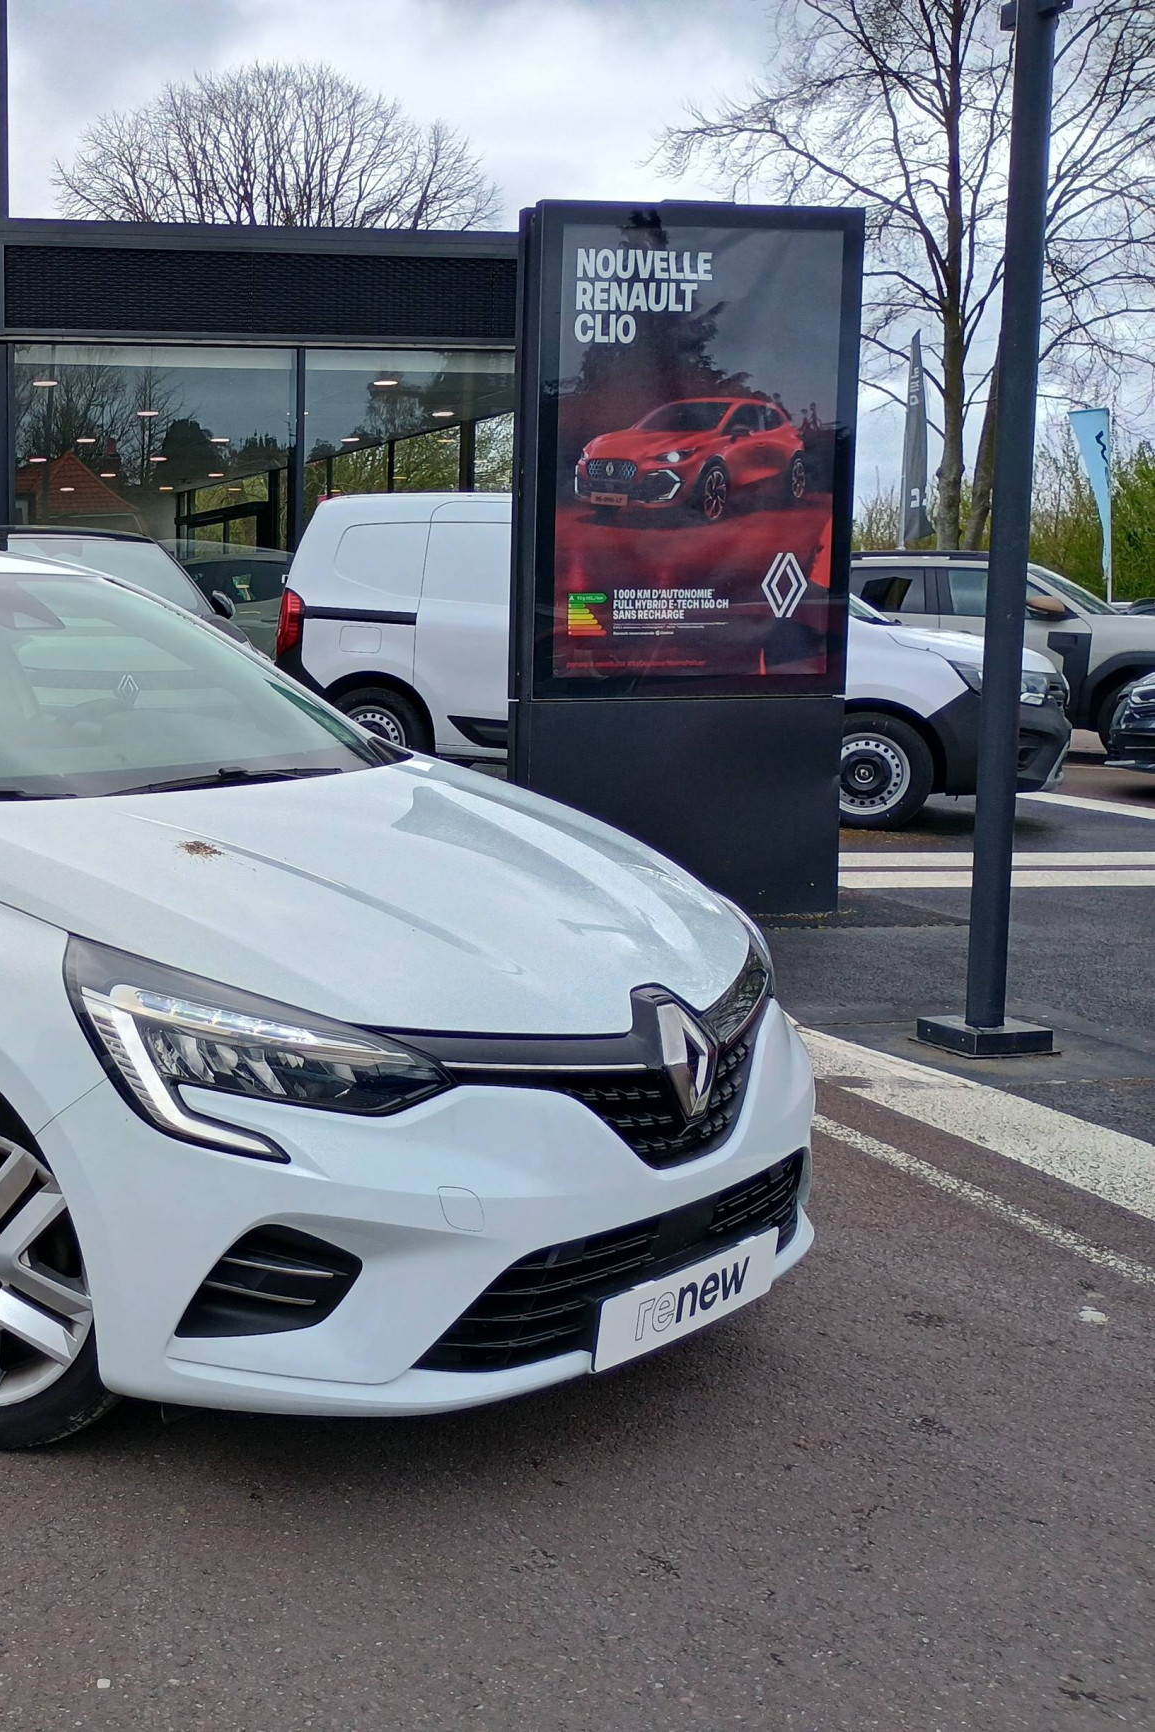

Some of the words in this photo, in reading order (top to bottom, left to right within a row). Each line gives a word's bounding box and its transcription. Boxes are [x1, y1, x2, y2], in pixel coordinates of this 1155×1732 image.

[576, 248, 713, 281] NOUVELLE
[575, 281, 699, 312] RENAULT
[574, 313, 636, 344] CLIO
[613, 599, 634, 609] FULL
[635, 599, 668, 609] HYBRID
[668, 599, 700, 609] E-TECH
[701, 599, 715, 609] 160
[716, 599, 729, 609] CH
[637, 589, 651, 599] KM
[613, 610, 636, 620] SANS
[637, 609, 685, 620] RECHARGE
[634, 1255, 751, 1342] renew
